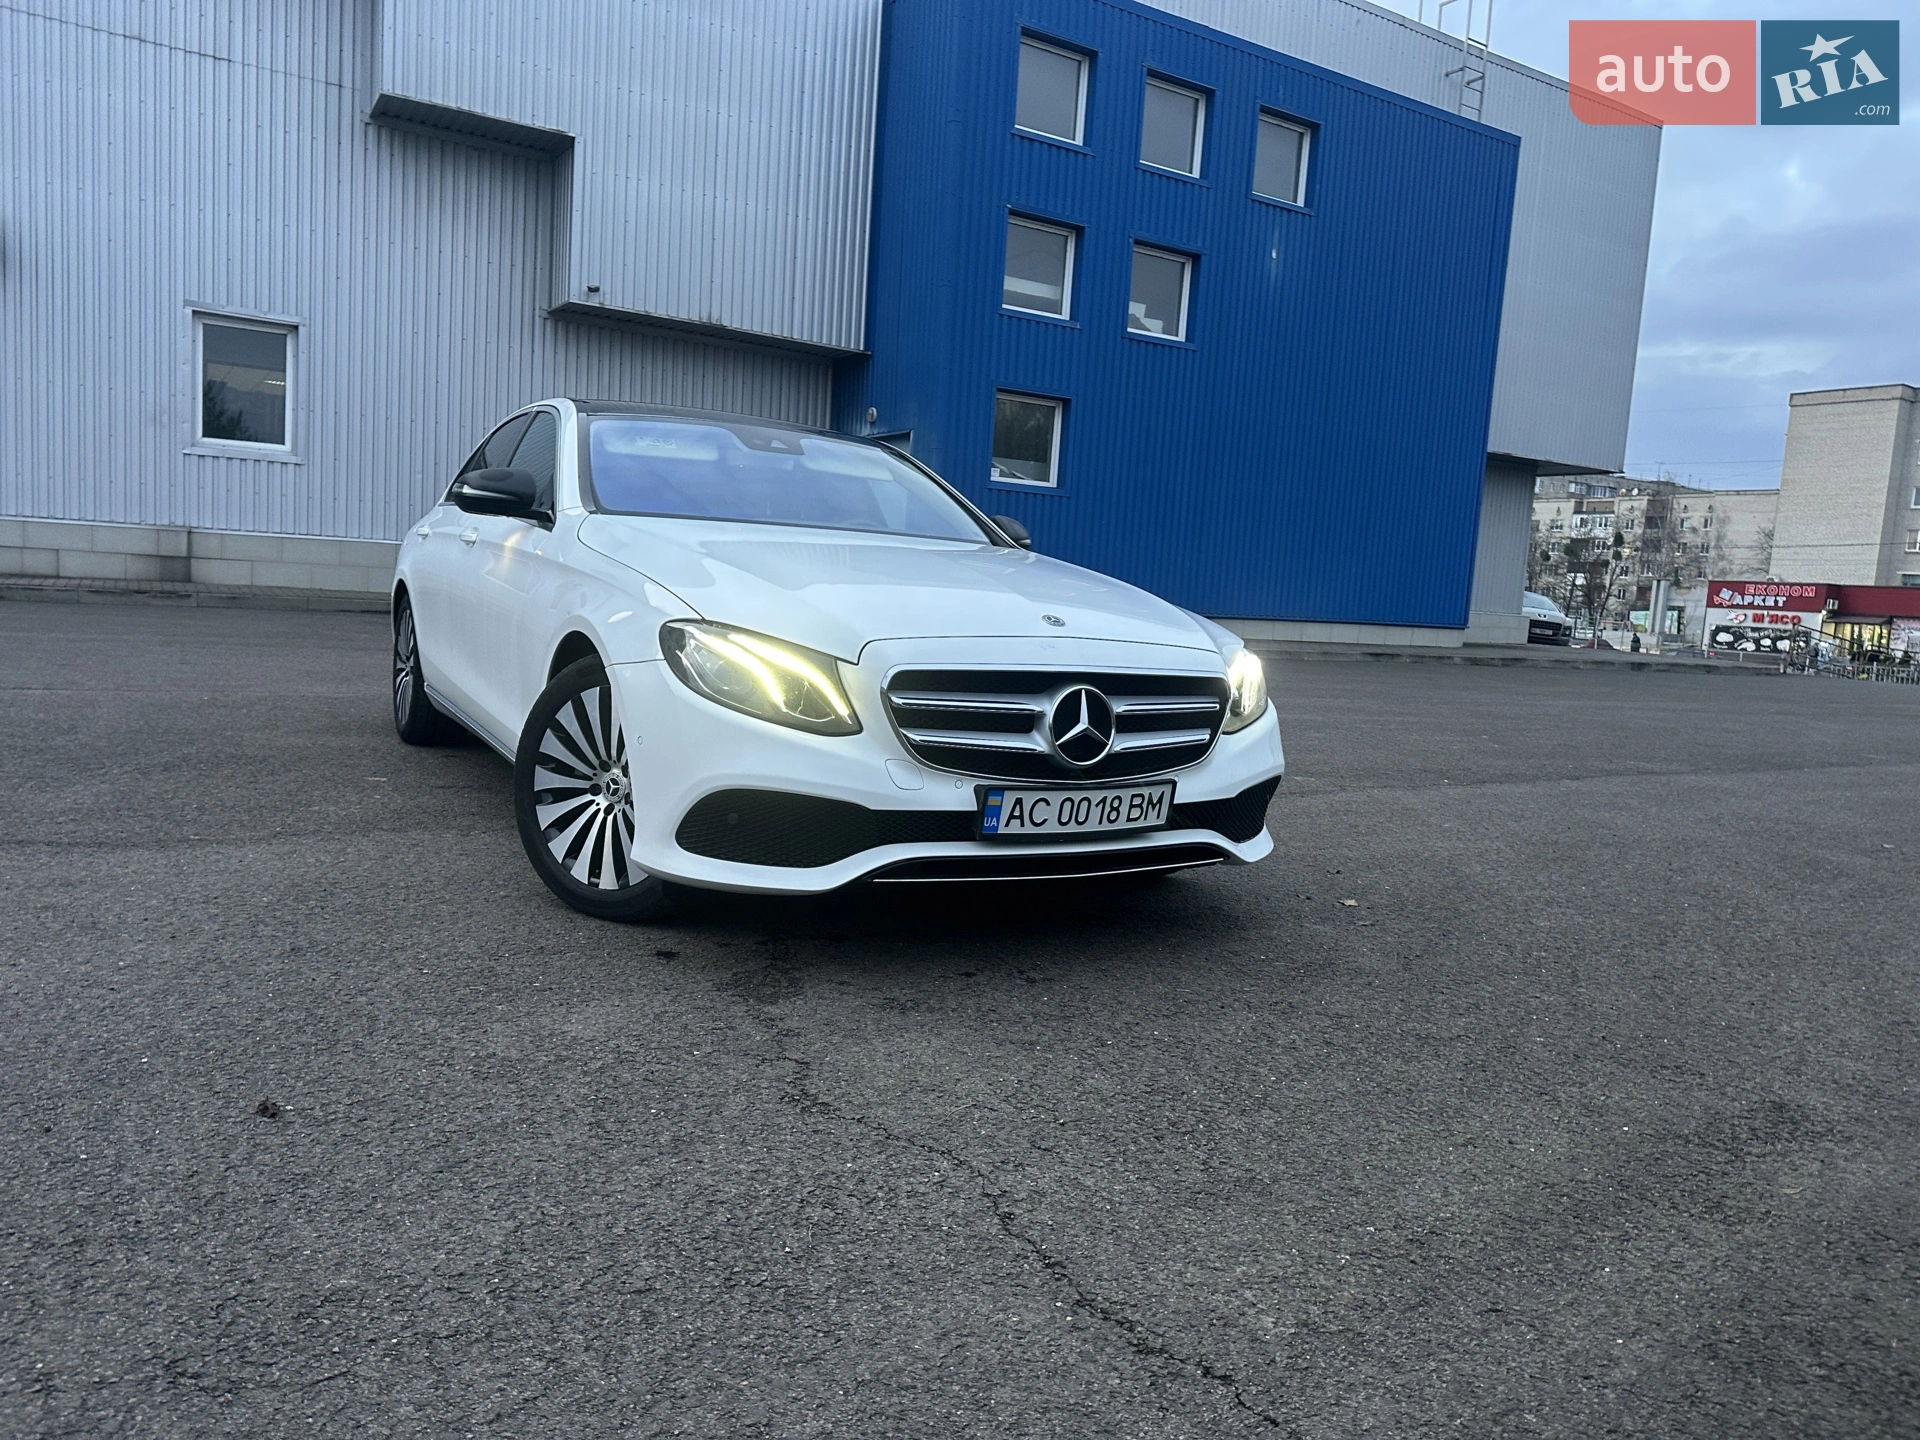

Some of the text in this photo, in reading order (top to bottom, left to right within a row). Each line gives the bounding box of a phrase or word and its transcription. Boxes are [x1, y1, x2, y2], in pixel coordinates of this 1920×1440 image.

[1745, 584, 1816, 597] ЕКОНОМ
[1004, 790, 1165, 828] AC 0018 BM
[984, 816, 998, 827] UA
